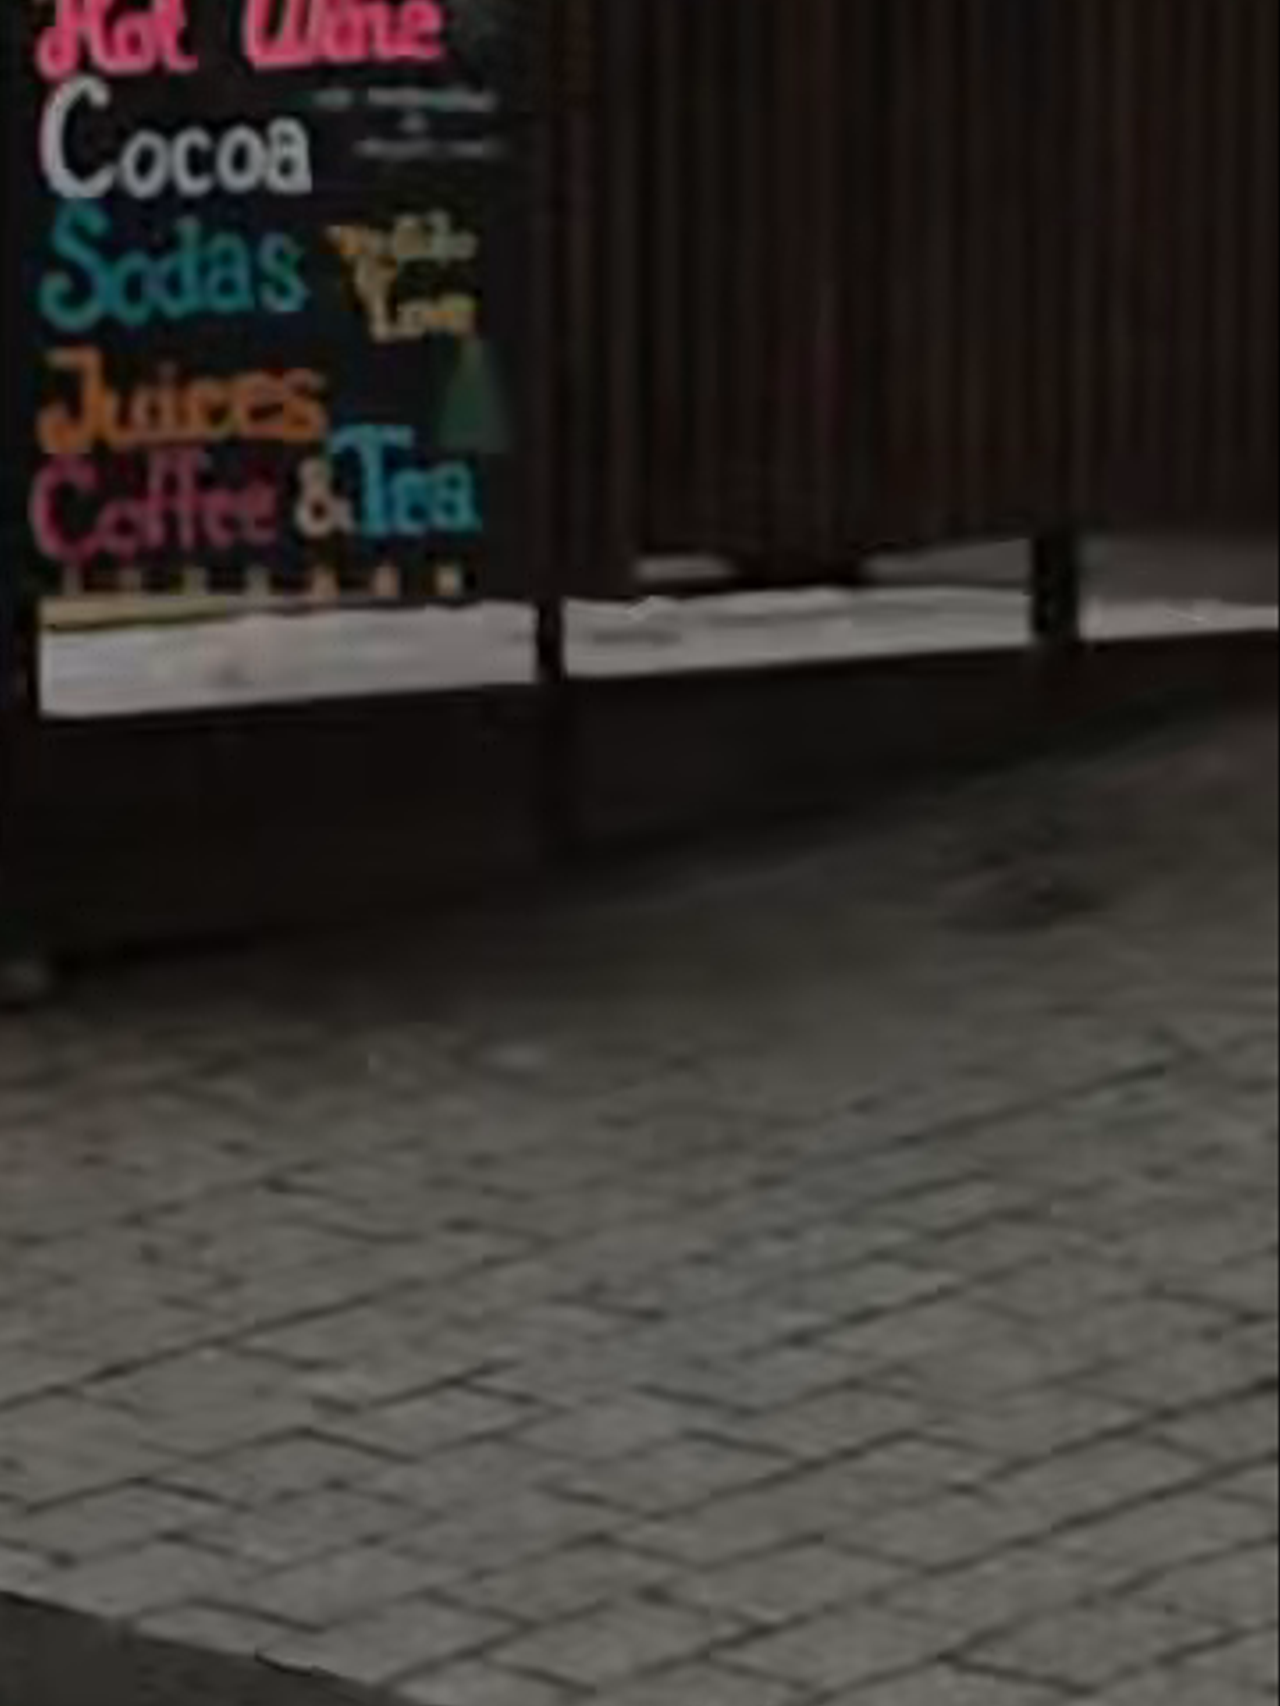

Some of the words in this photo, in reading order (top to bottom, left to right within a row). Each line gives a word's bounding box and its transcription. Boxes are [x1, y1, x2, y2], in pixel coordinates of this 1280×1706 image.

[40, 75, 314, 199] Cocoa
[42, 198, 310, 331] Sodas
[36, 347, 328, 454] Juices
[31, 448, 280, 565] Coffee
[329, 424, 481, 536] Tea
